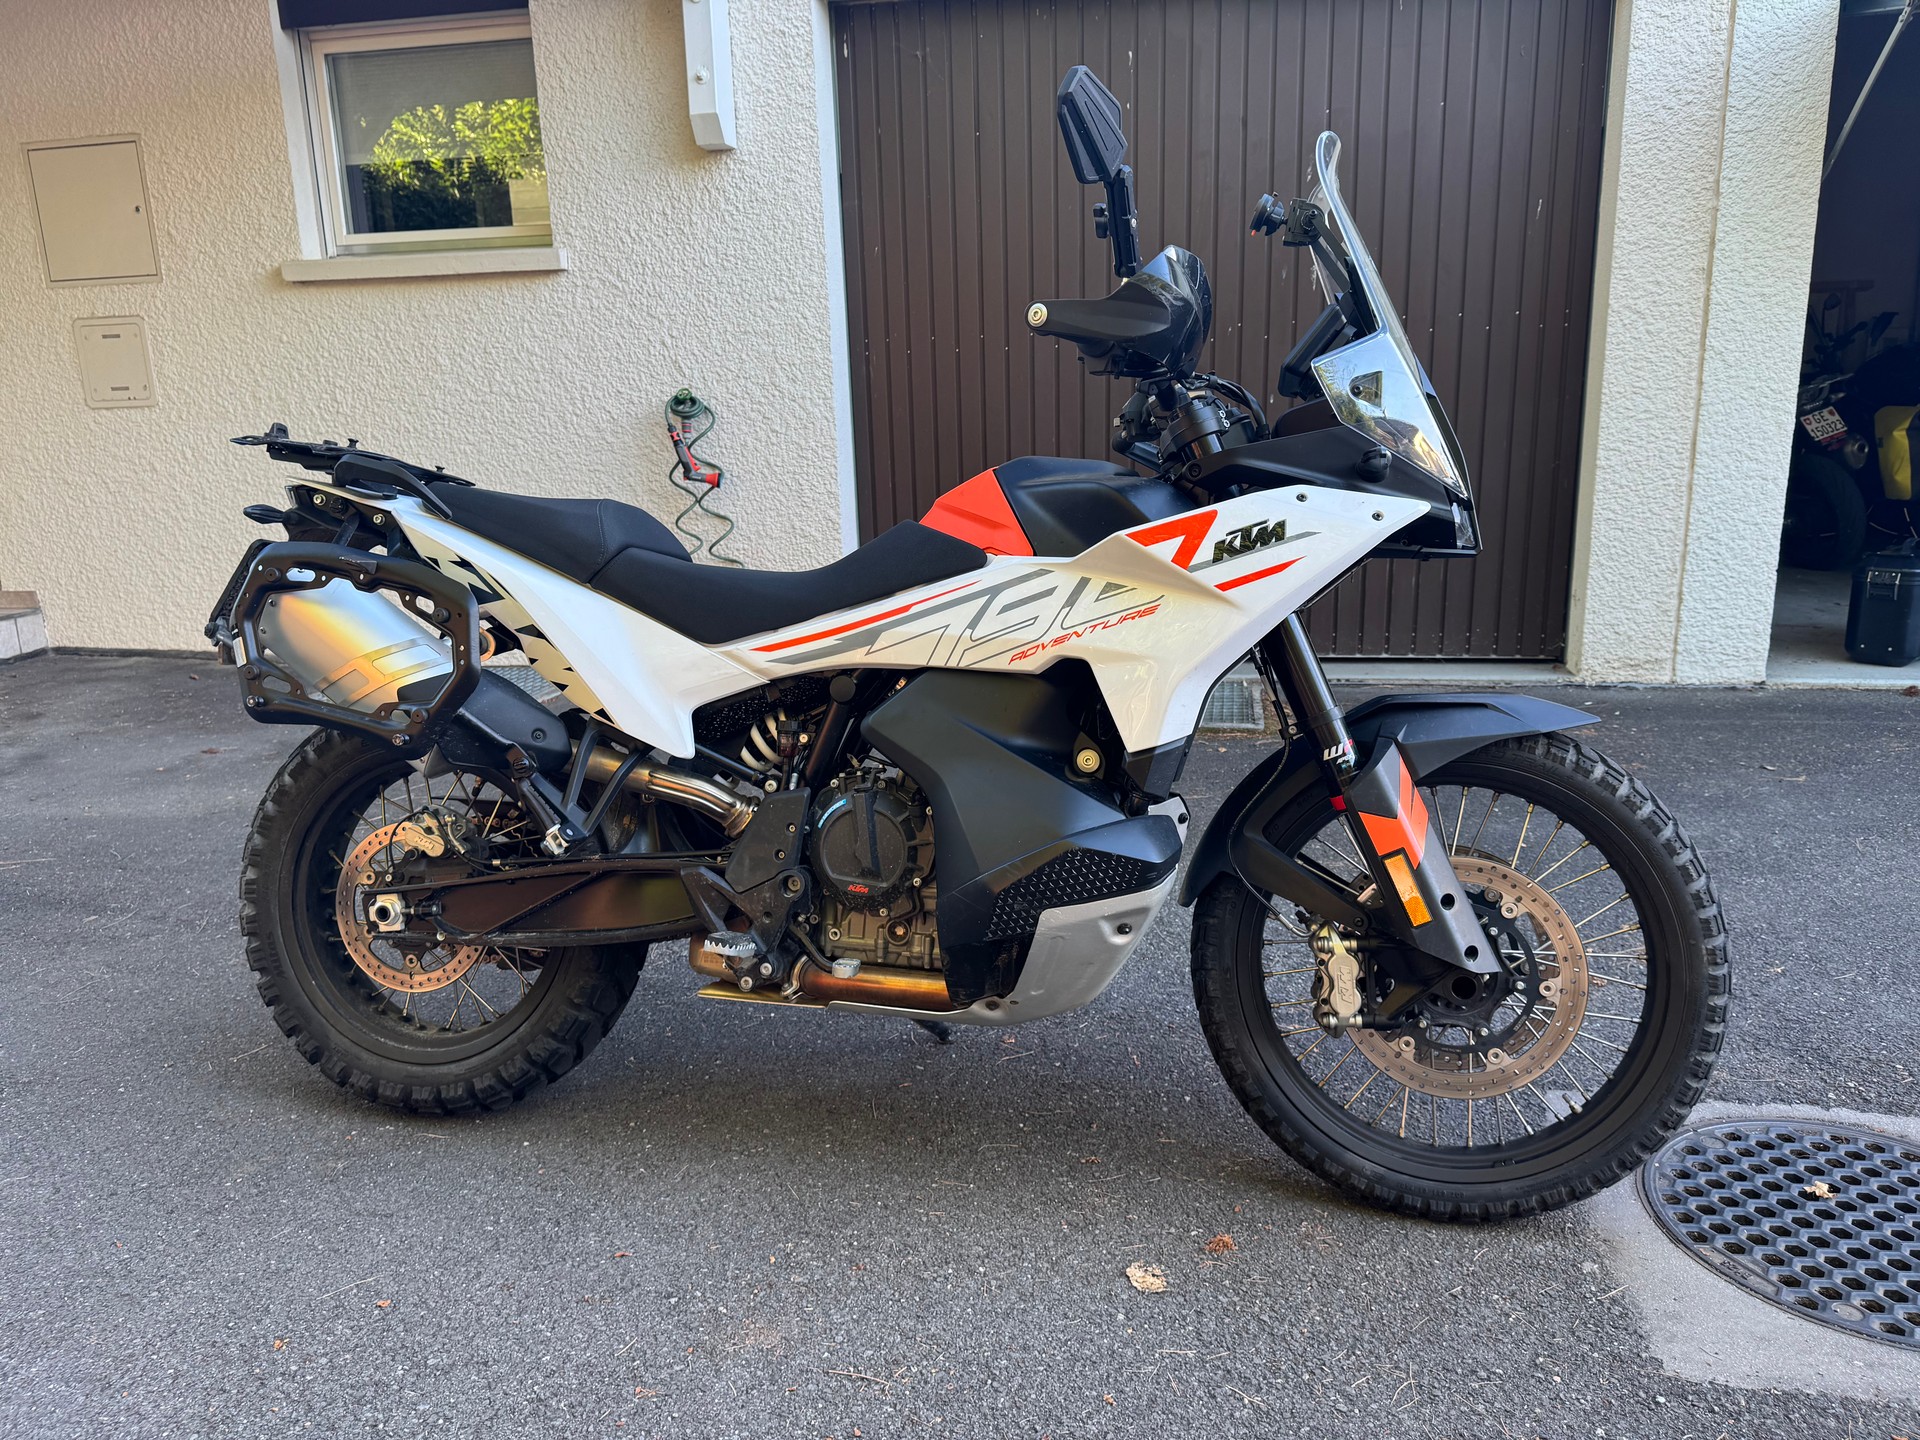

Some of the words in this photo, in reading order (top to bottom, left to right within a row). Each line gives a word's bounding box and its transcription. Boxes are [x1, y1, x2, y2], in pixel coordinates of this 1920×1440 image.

[1812, 411, 1829, 424] GE
[1811, 419, 1845, 438] 150323
[1212, 518, 1287, 563] KTM
[1008, 603, 1161, 665] ADVENTURE
[847, 884, 869, 894] KTM
